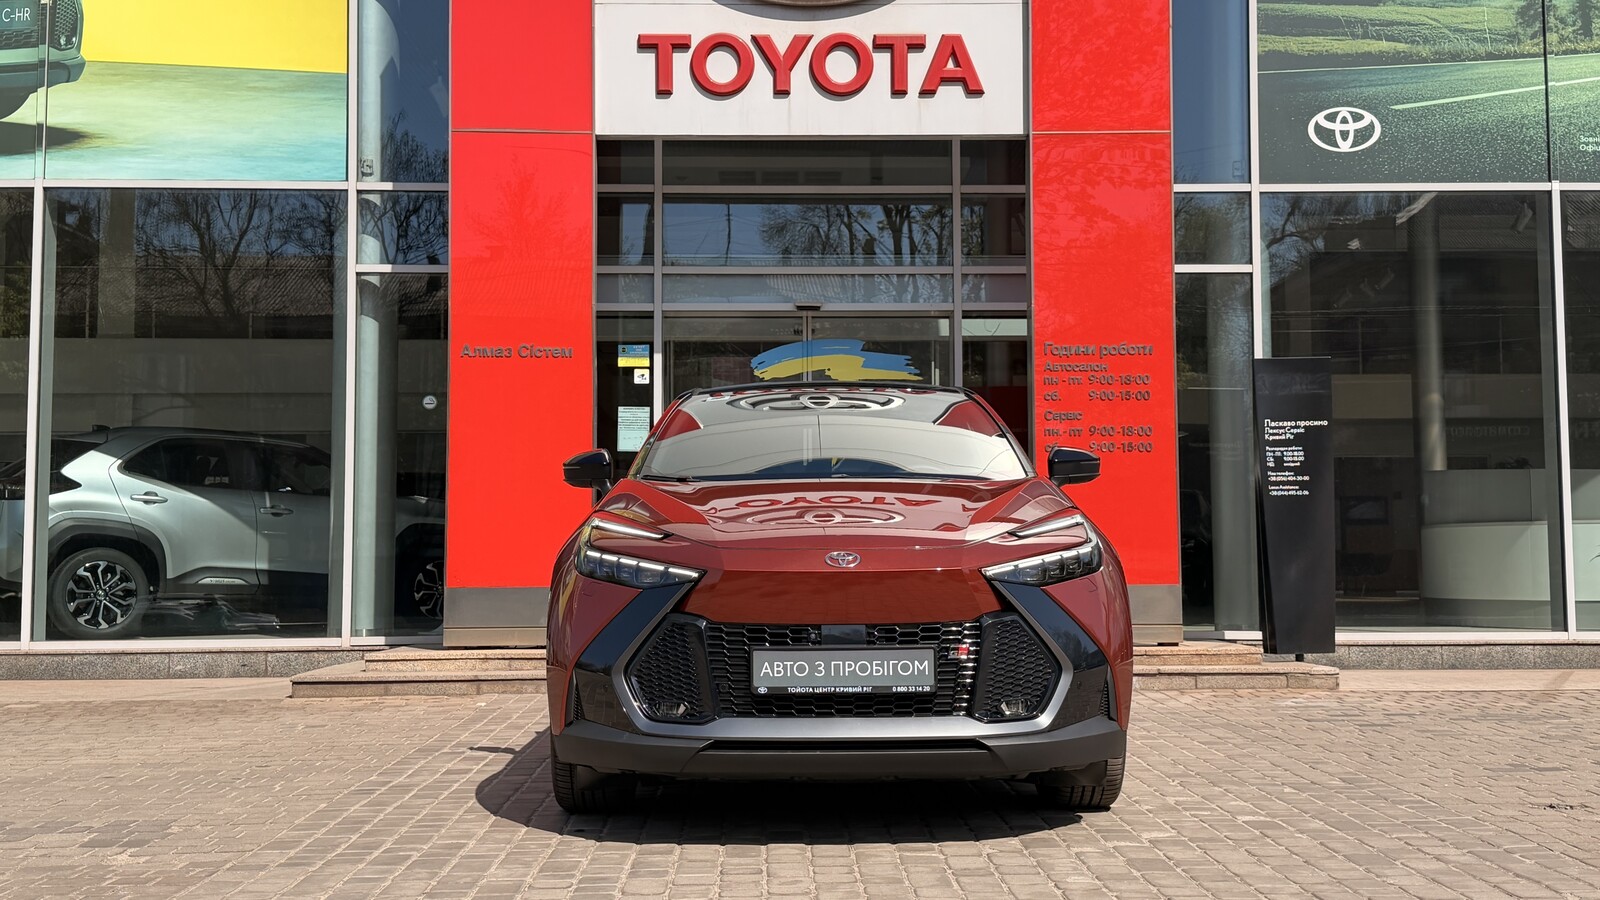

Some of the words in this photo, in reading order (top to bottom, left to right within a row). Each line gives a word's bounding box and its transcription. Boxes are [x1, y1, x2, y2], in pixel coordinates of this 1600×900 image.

[2, 7, 31, 22] C-HR
[637, 32, 985, 98] TOYOTA
[460, 344, 512, 358] Алмаз
[517, 343, 573, 358] Сістем
[1043, 342, 1096, 358] Години
[1099, 341, 1153, 359] роботи
[1043, 361, 1108, 372] Автосалон
[1087, 374, 1151, 386] 9:00-18:00
[1043, 391, 1062, 401] сб.
[1087, 390, 1151, 401] 9:00-15:00
[1044, 410, 1083, 423] Сервіс
[1264, 418, 1296, 427] Ласкаво
[1088, 425, 1153, 437] 9:00-18:00
[760, 661, 809, 677] АВТО
[814, 661, 825, 677] З
[830, 660, 929, 677] ПРОБІГОМ
[787, 685, 814, 693] ТОЙОТА
[814, 686, 835, 694] ЦЕНТР
[835, 685, 862, 693] КРИВИЙ
